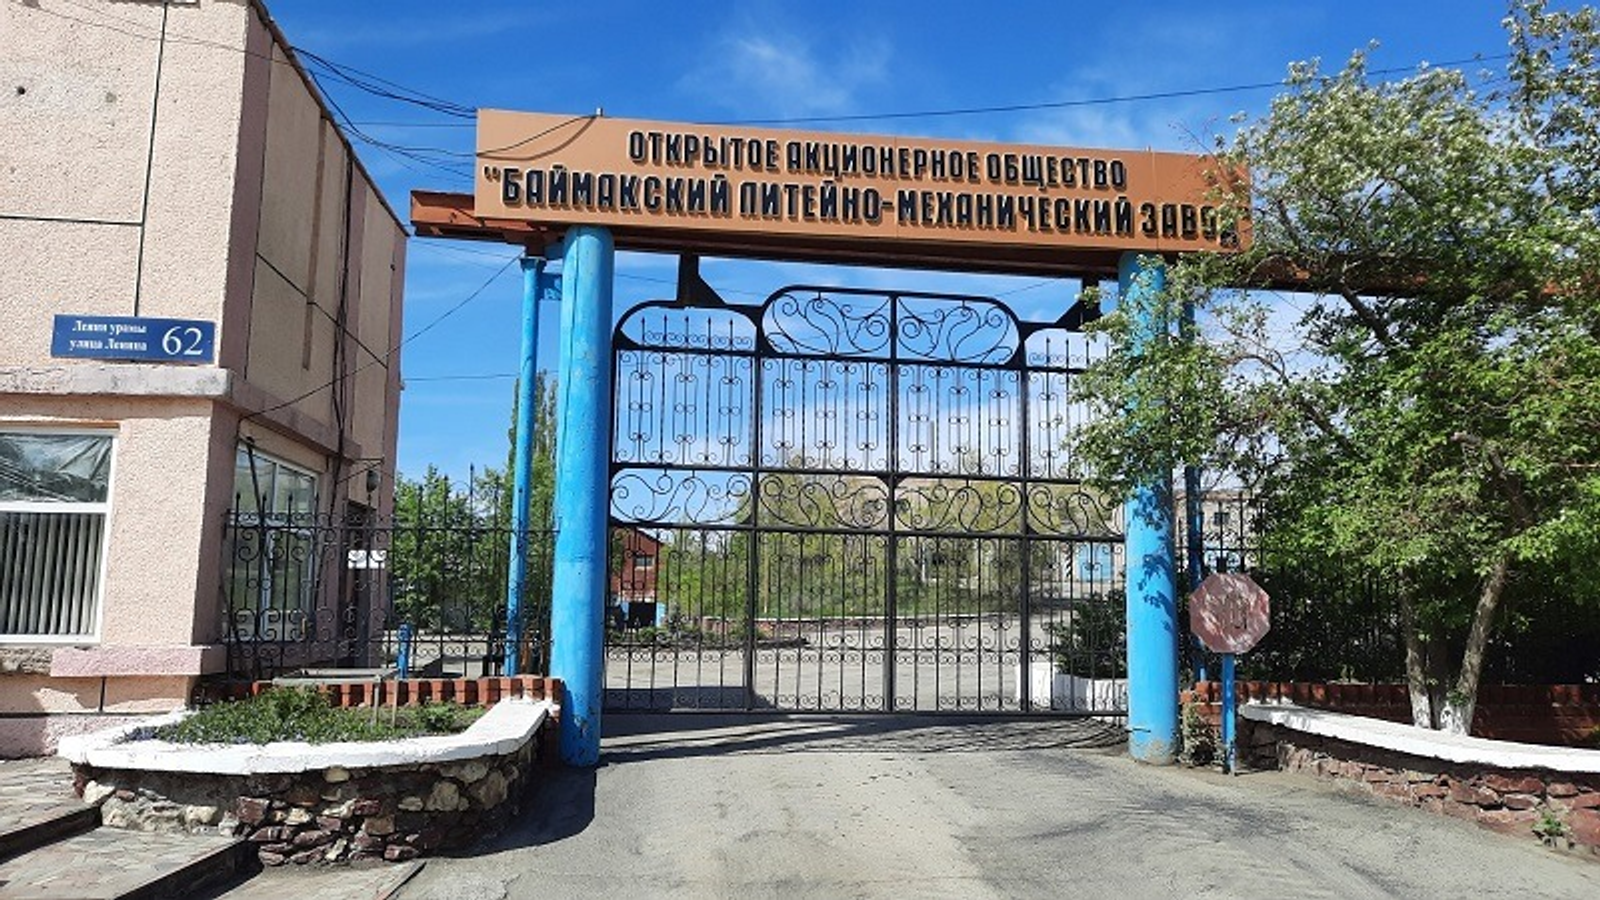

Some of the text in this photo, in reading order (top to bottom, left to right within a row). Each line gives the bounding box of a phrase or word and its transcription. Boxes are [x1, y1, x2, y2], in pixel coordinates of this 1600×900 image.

[628, 131, 1127, 190] ОТКРЫТОЕ АКЦИОНЕРНОЕ ОБЩЕСТВО
[739, 178, 1134, 237] ЛИТЕЙНО-МЕХАНИЧЕСКИЙ
[69, 338, 148, 351] улица Ленина
[162, 326, 204, 356] 62
